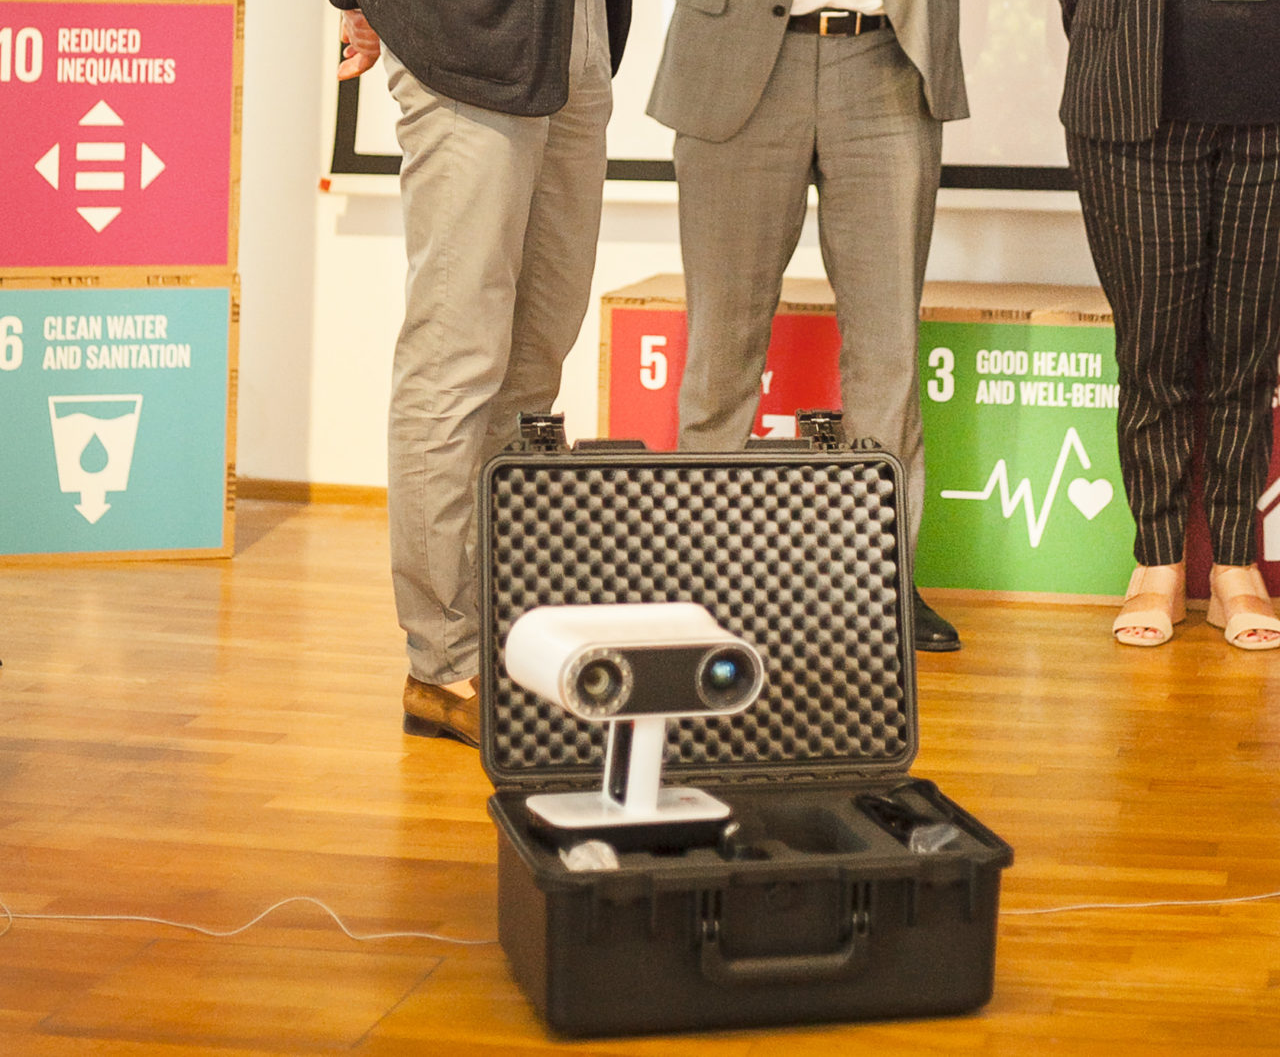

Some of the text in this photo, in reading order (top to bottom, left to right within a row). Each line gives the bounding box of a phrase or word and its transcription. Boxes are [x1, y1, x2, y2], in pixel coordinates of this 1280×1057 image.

[0, 27, 44, 83] 10
[57, 28, 141, 54] REDUCED
[57, 58, 176, 86] INEQUALITIES
[43, 315, 168, 341] CLEAN WATER
[0, 315, 24, 371] 6
[42, 344, 192, 371] AND SANITATION
[640, 334, 668, 391] 5
[976, 349, 1101, 378] GOOD HEALTH
[927, 347, 955, 403] 3
[975, 380, 1015, 405] AND
